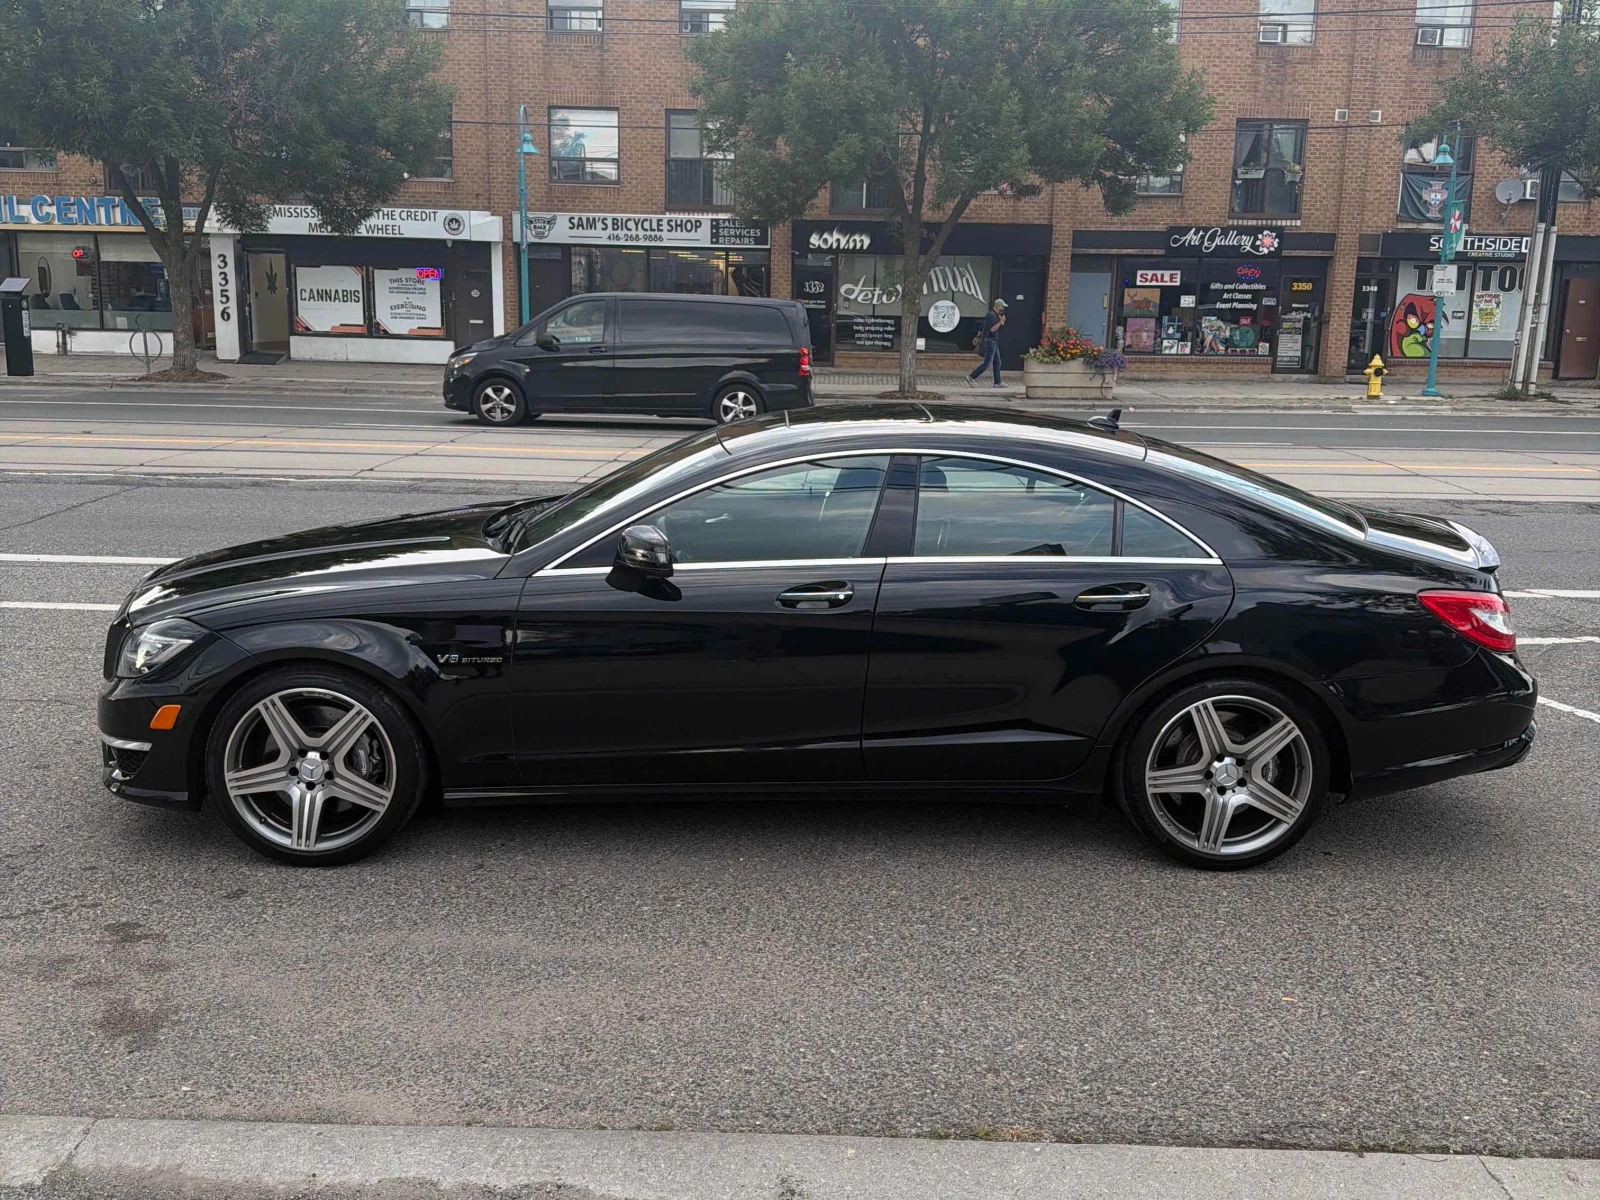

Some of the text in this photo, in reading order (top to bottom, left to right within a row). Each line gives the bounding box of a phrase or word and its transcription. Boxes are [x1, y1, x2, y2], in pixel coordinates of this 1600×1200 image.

[400, 211, 439, 224] CREDIT
[568, 216, 703, 233] SAM'S BICYCLE SHOP
[364, 225, 404, 236] WHEEL
[718, 228, 762, 238] SERVICES
[606, 233, 665, 243] 416-268-9886
[718, 237, 756, 246] REPAIRS
[1169, 227, 1261, 255] Art Gallery
[1468, 251, 1494, 259] CREATIVE
[416, 269, 441, 279] OPEN
[1237, 266, 1261, 278] OPEN
[389, 277, 426, 286] THIS STORE
[1138, 272, 1179, 284] SALE
[217, 253, 231, 322] 3356
[803, 280, 825, 294] 3352
[1210, 282, 1223, 290] Gifts
[1235, 282, 1267, 290] Collectibles
[1291, 282, 1313, 291] 3350
[299, 288, 361, 304] CANNABIS
[1222, 292, 1252, 300] Art Classes
[1216, 301, 1258, 311] Event Planning
[437, 654, 459, 663] V8
